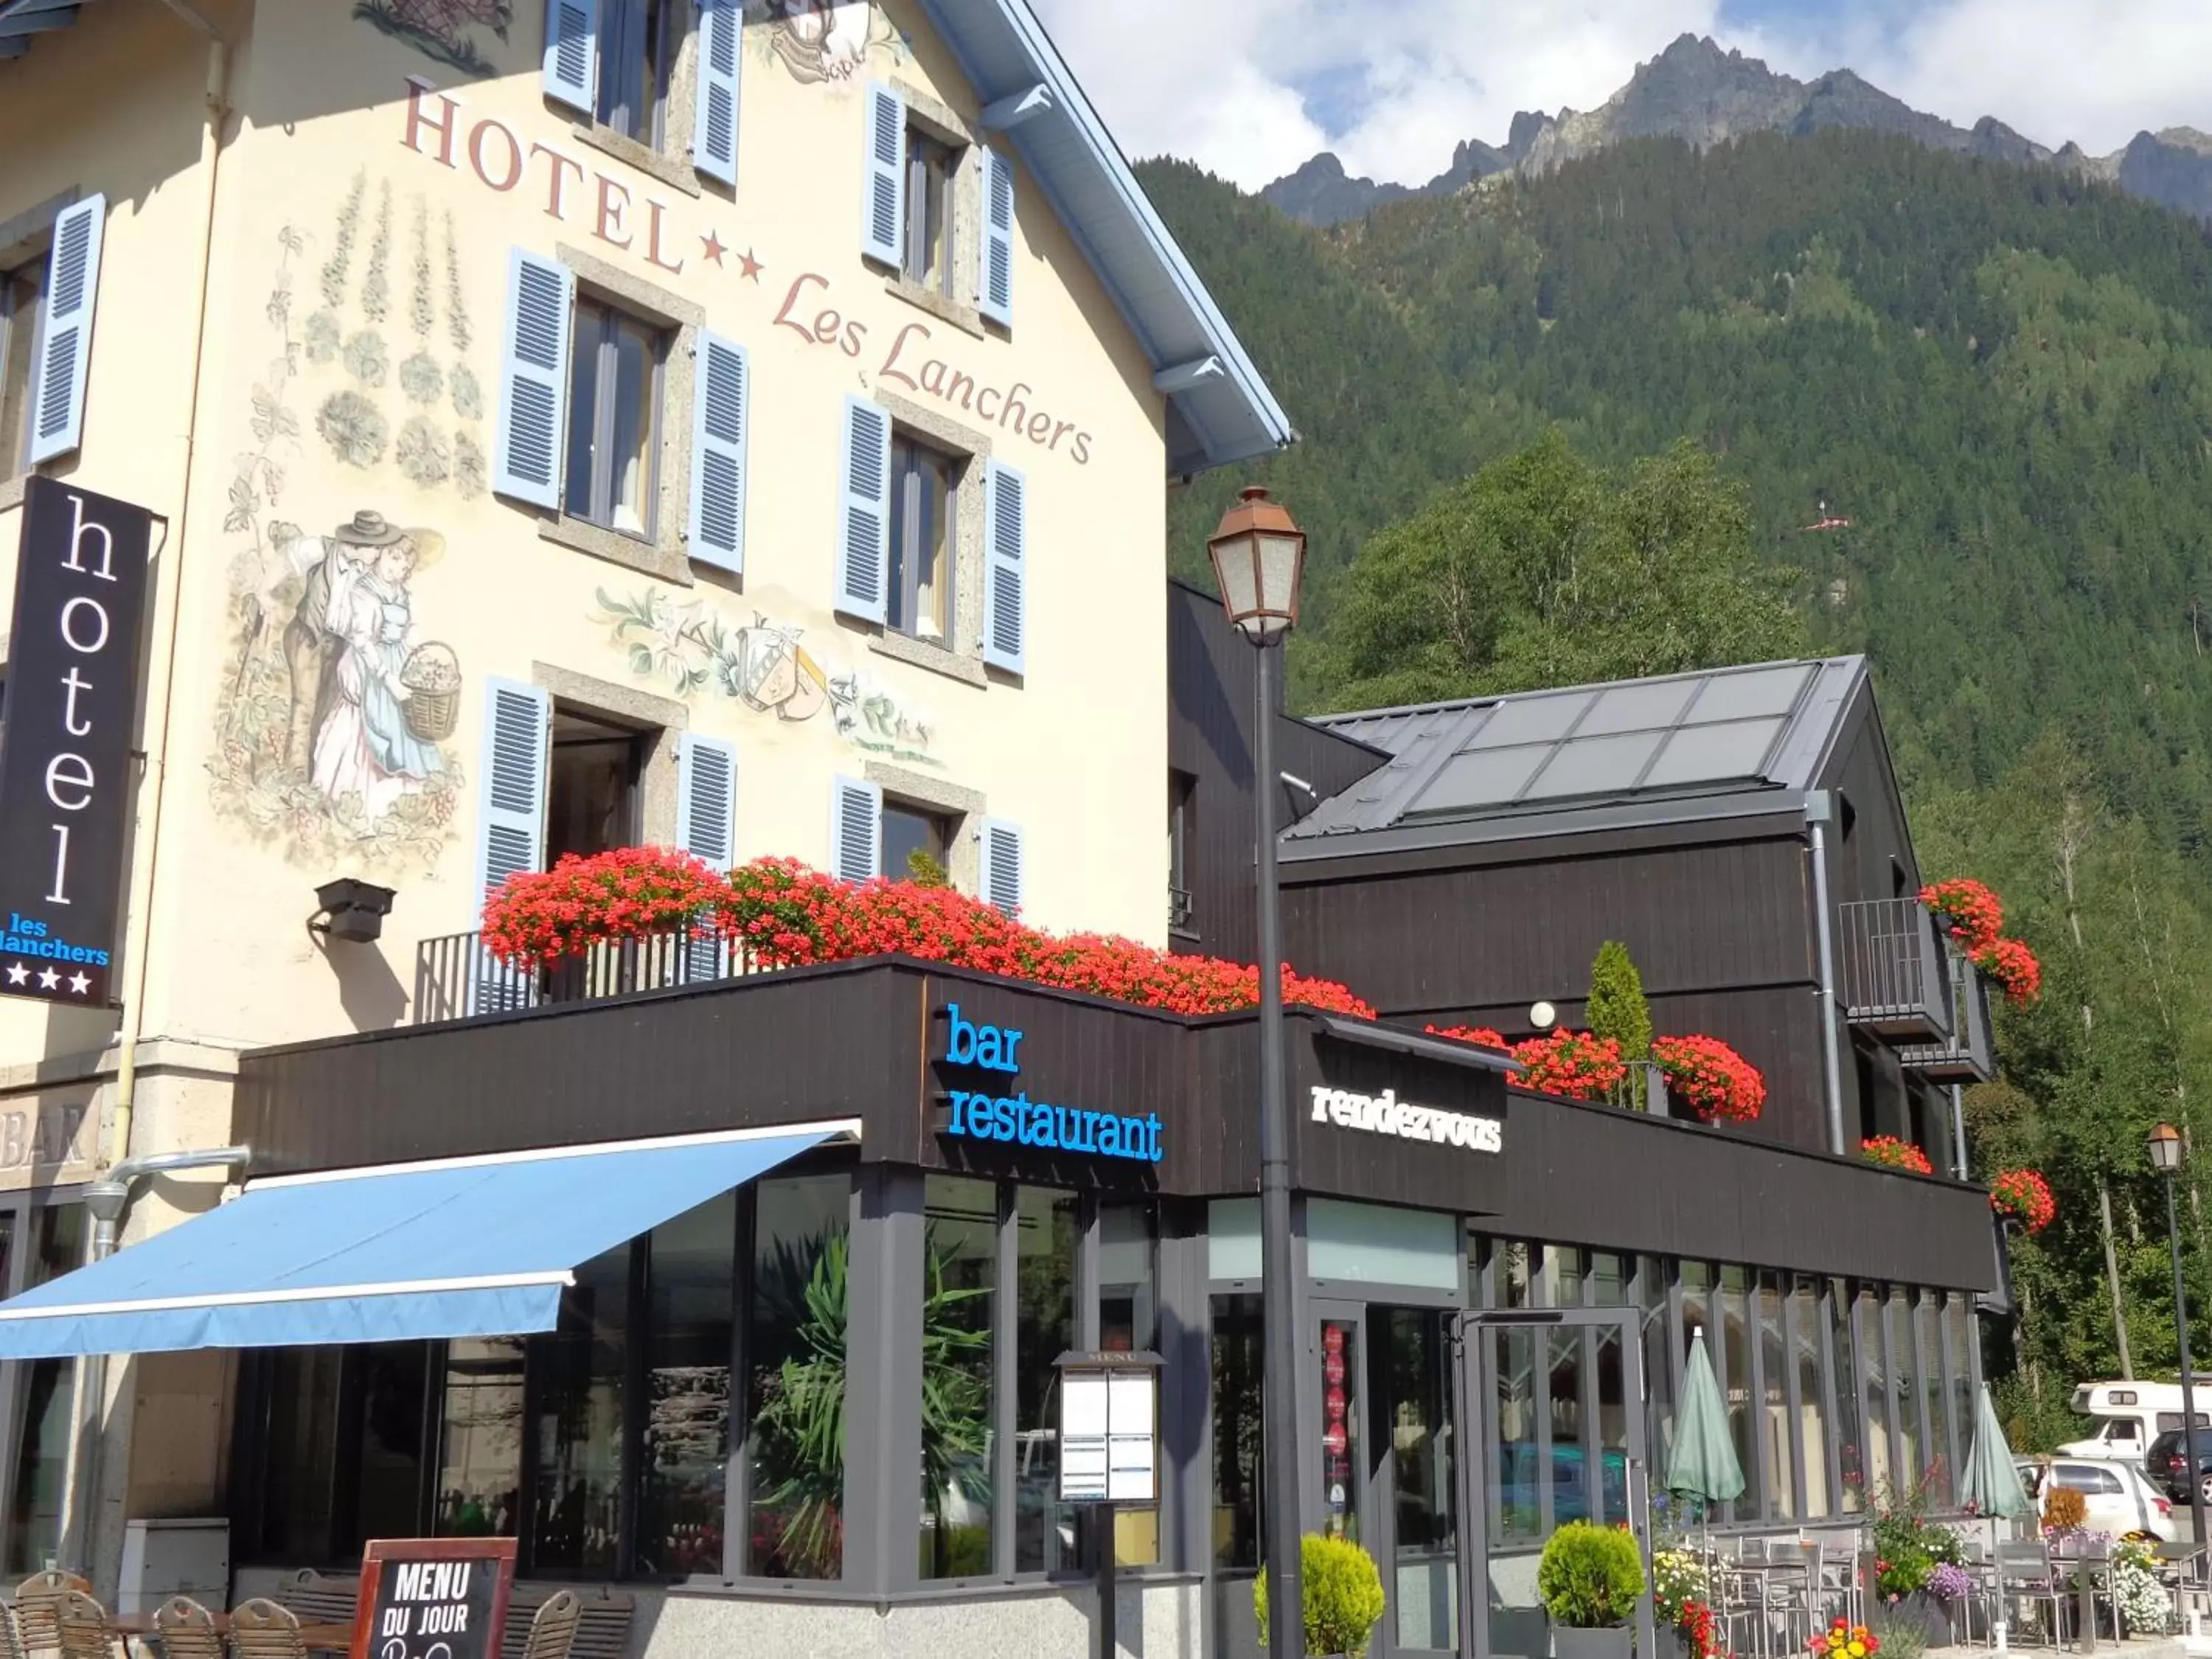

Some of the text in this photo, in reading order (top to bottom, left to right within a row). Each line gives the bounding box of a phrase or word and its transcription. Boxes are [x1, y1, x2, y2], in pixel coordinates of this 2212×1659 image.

[400, 74, 1093, 465] HOTEL Les Lanchers
[45, 495, 117, 905] hotel
[0, 931, 109, 966] lanchers
[10, 913, 47, 937] les
[946, 1003, 1023, 1073] bar
[0, 1104, 87, 1170] BAR
[948, 1091, 1163, 1162] restaurant
[1310, 1085, 1502, 1153] rendezvous
[1088, 1352, 1137, 1363] MENU
[394, 1562, 471, 1601] MENU
[382, 1604, 469, 1637] DU JOUR
